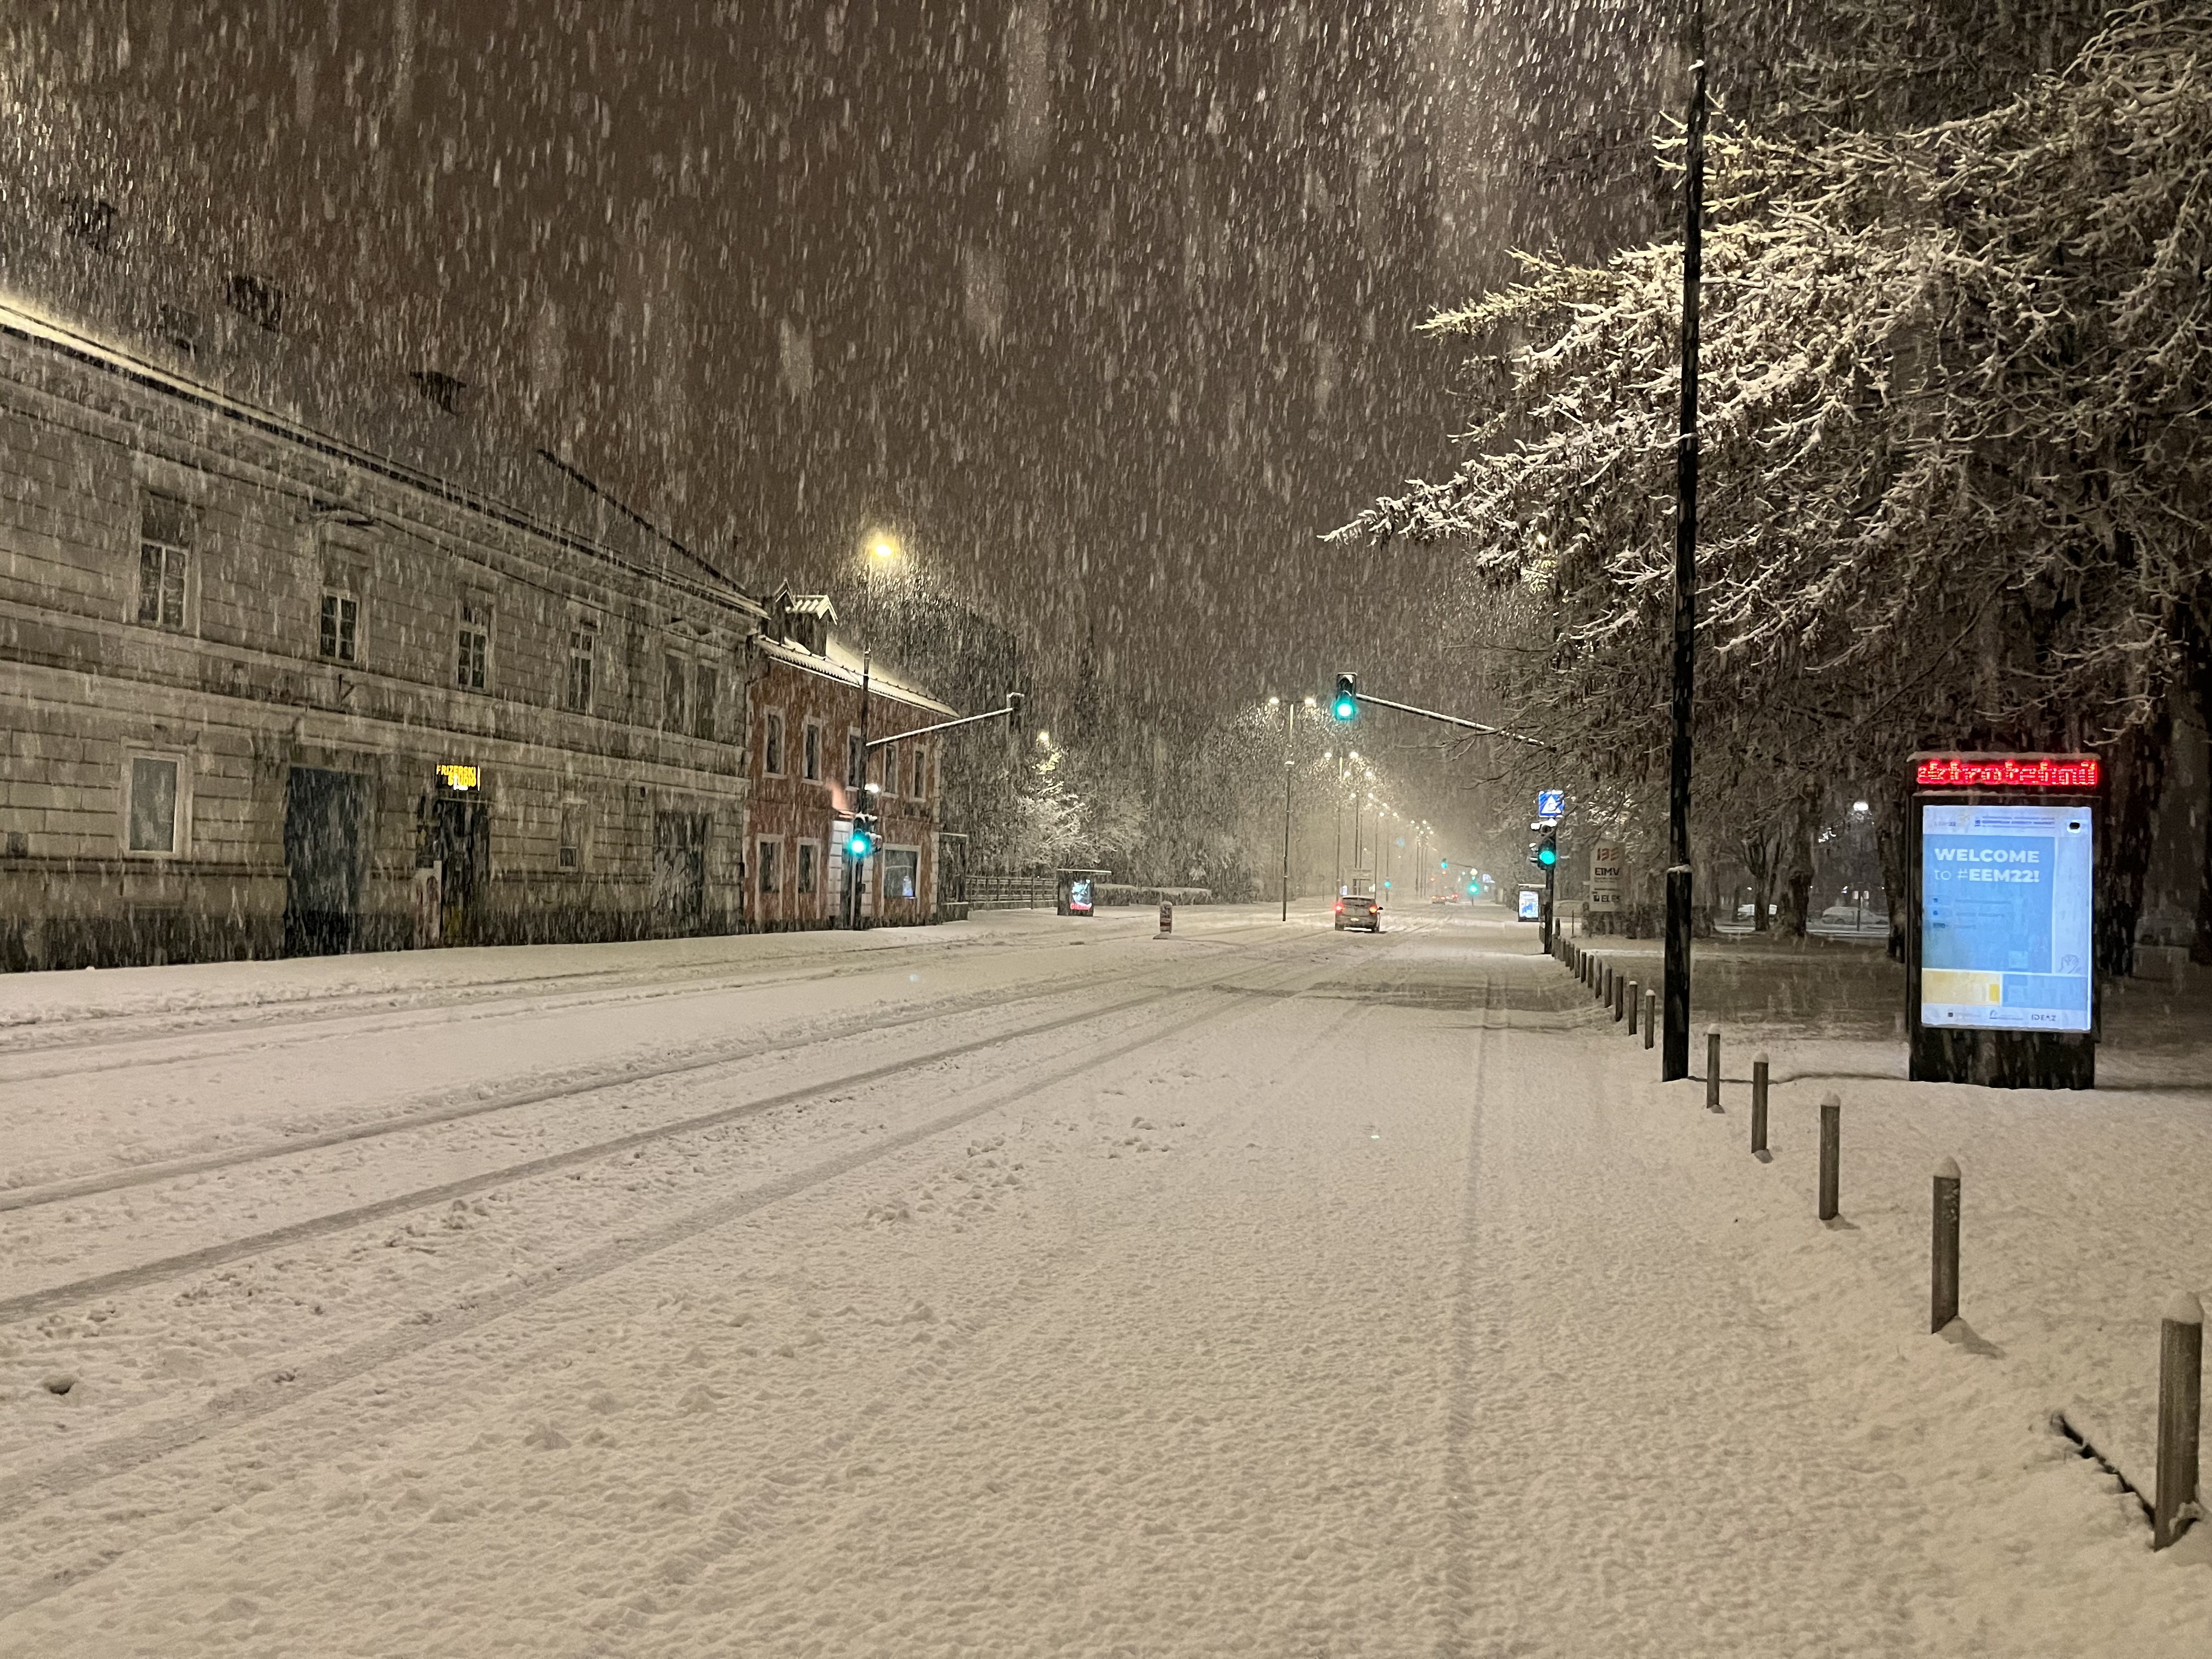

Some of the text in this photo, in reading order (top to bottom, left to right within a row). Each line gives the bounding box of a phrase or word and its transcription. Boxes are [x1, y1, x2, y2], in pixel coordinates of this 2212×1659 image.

[1934, 848, 2040, 863] WELCOME
[1934, 868, 2040, 883] to #EEM22!
